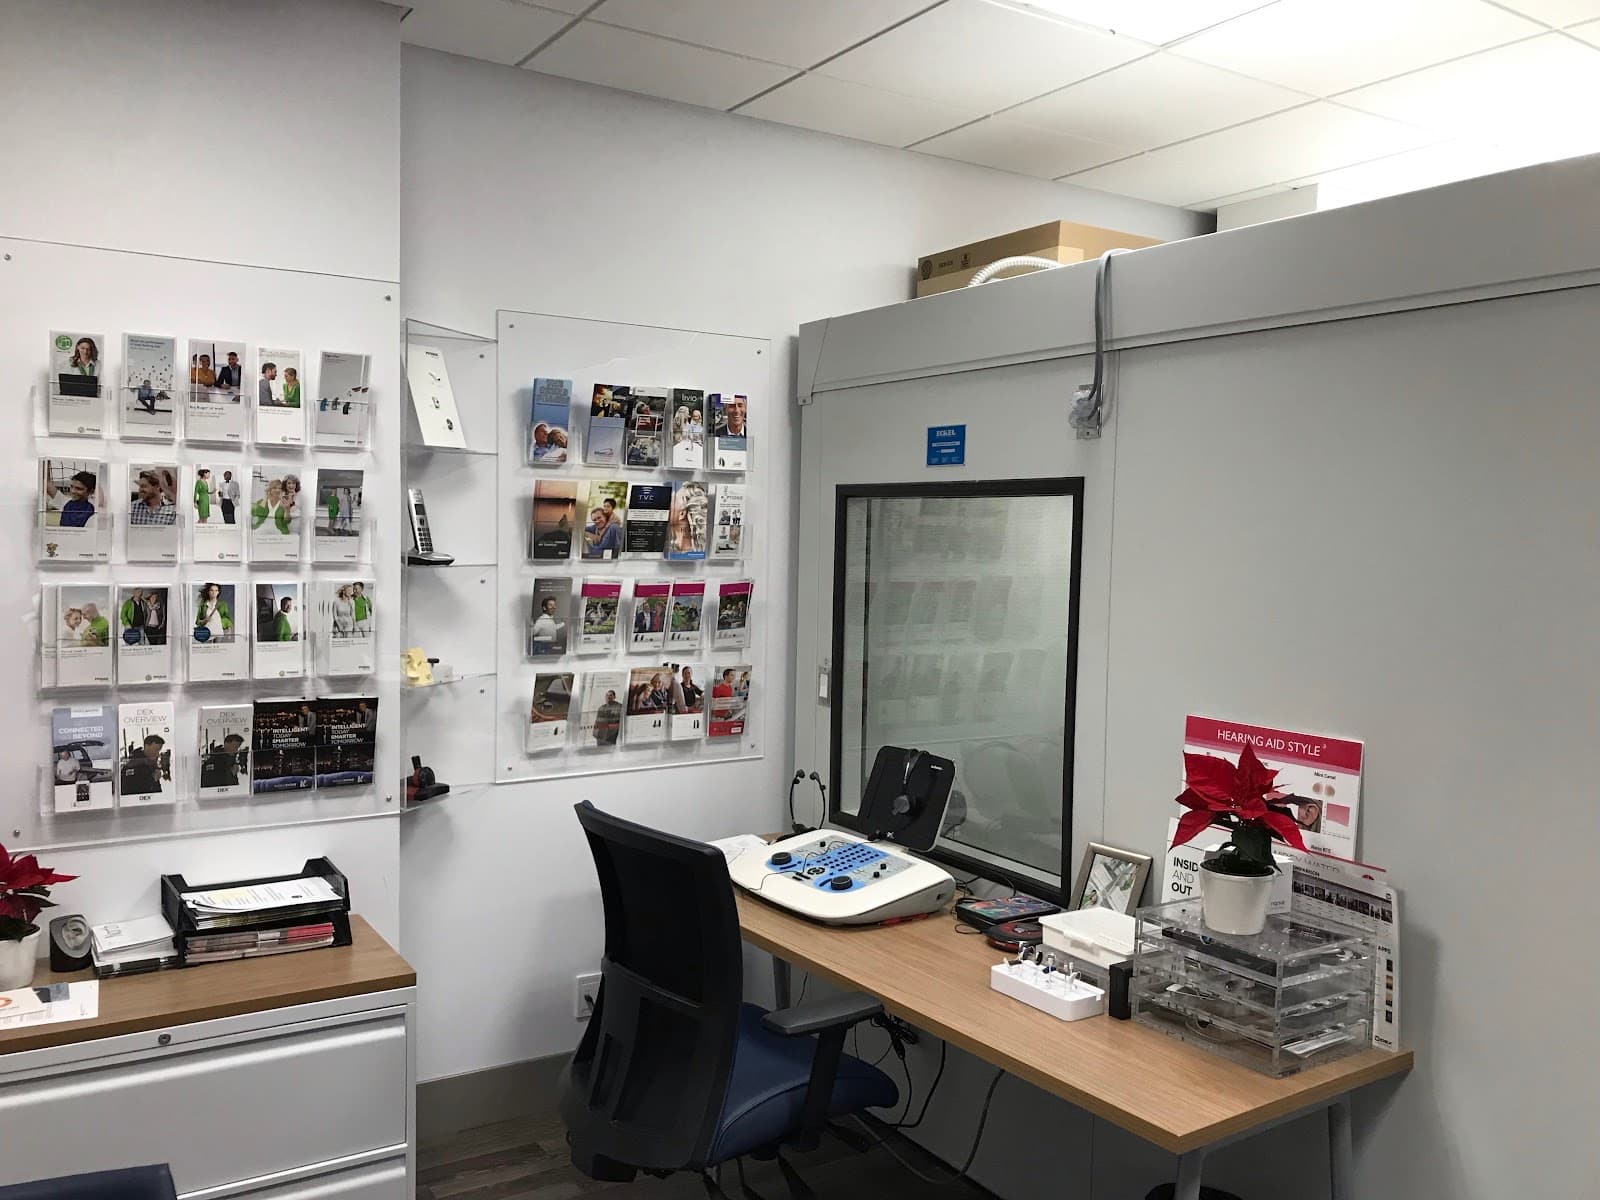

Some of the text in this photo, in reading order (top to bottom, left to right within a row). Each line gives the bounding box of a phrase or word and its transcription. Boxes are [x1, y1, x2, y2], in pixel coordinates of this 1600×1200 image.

[1217, 729, 1264, 747] HEARING
[1265, 737, 1285, 750] AID
[1173, 856, 1199, 872] INSID
[1172, 869, 1195, 884] AND
[1171, 882, 1193, 896] OUT
